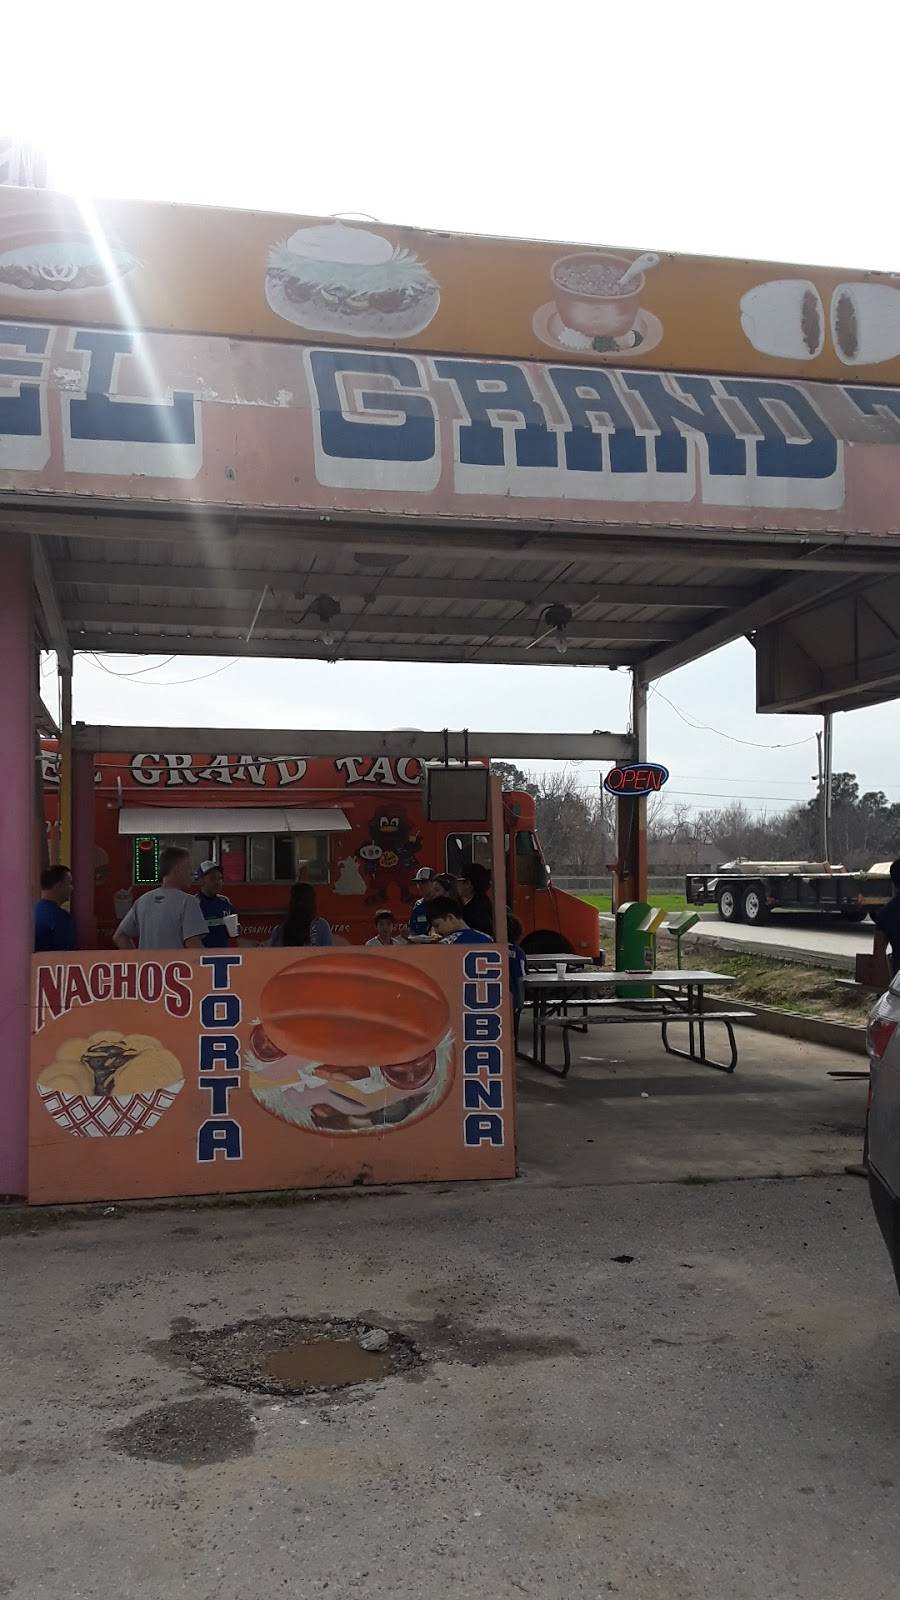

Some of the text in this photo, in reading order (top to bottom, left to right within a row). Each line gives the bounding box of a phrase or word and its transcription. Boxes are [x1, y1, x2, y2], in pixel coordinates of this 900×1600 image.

[303, 349, 845, 509] GRAND
[131, 753, 308, 786] GRAND
[607, 768, 663, 790] OPEN
[35, 961, 193, 1034] NACHOS
[463, 950, 504, 1147] CUBANA
[197, 955, 243, 1163] TORTA
